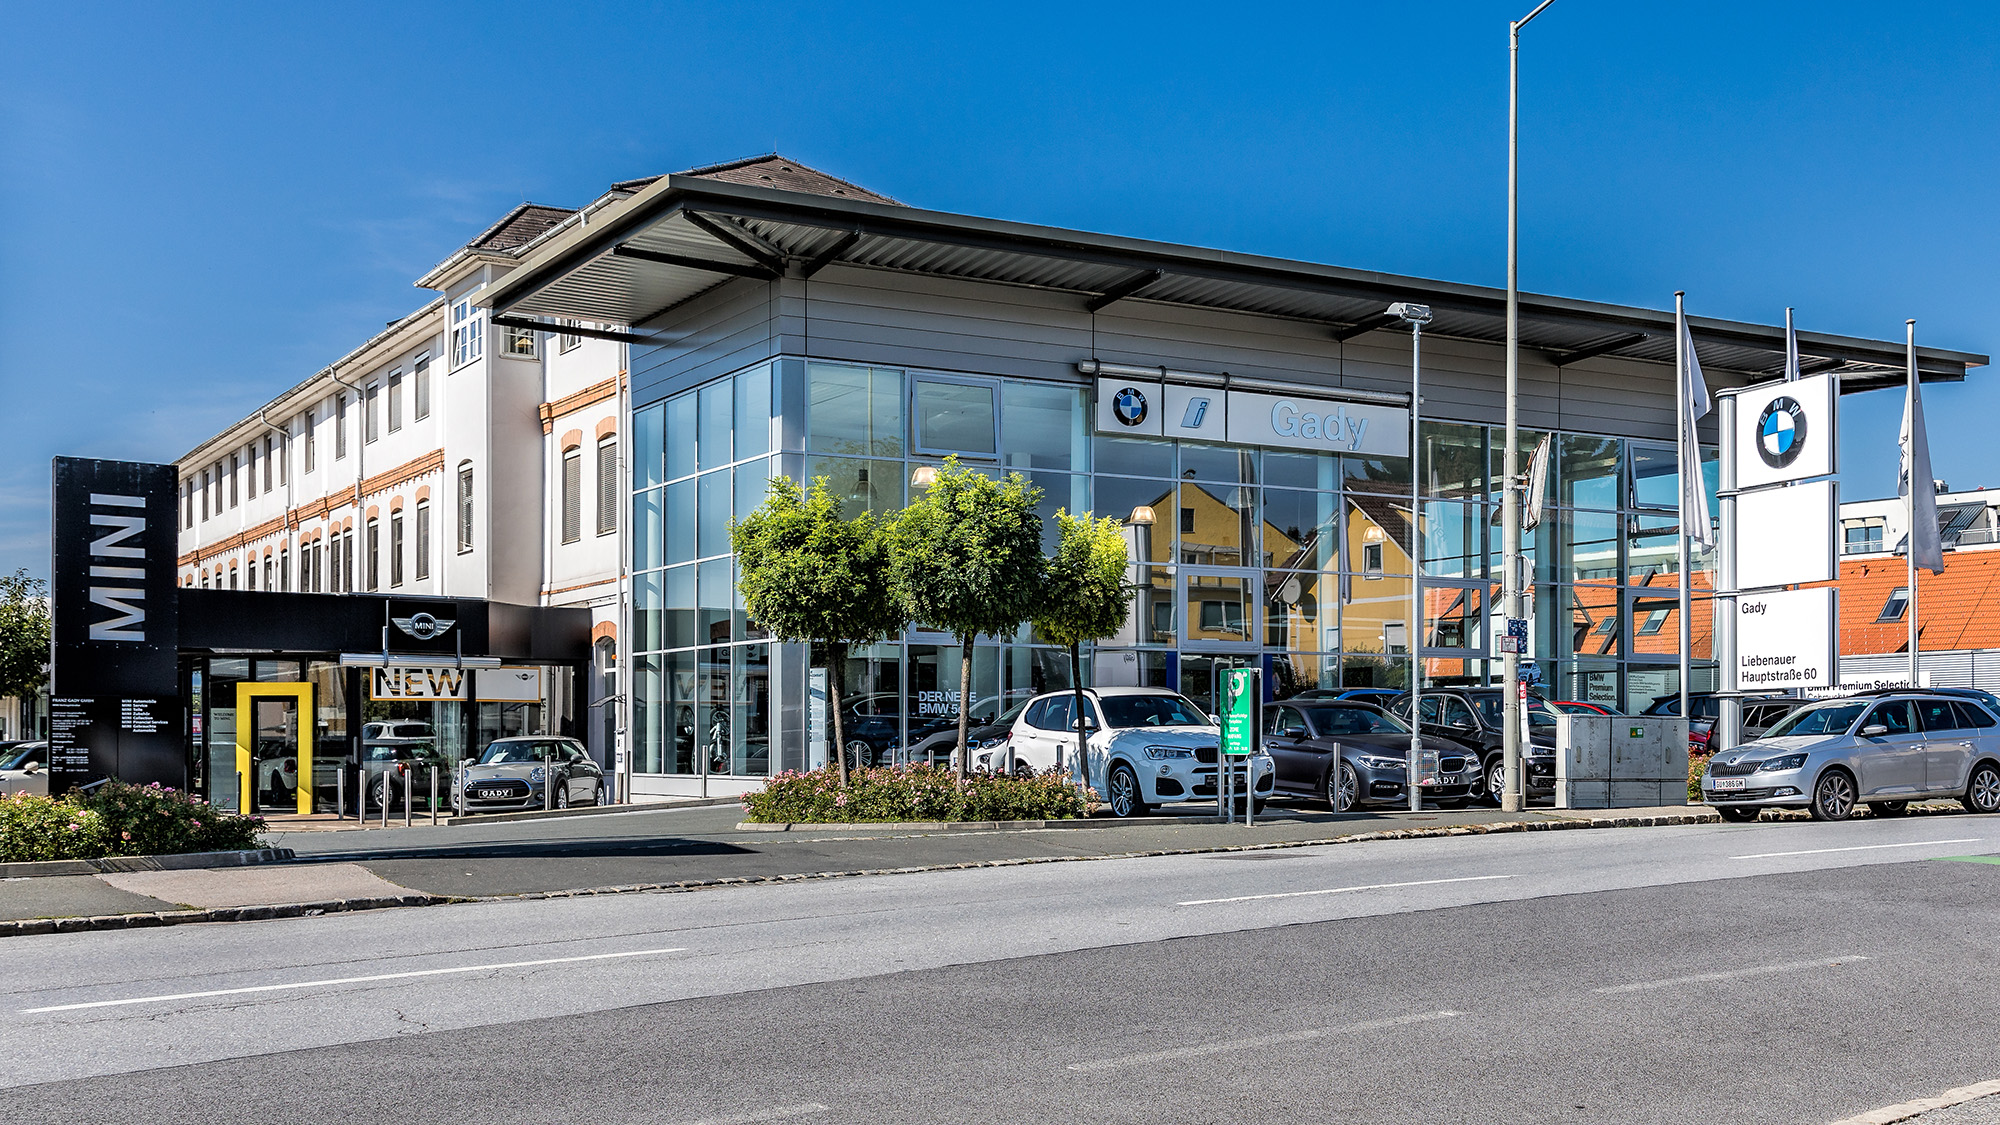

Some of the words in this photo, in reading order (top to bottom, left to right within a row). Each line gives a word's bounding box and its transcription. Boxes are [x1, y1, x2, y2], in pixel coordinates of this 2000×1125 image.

[1116, 388, 1146, 403] BMW
[1760, 398, 1802, 426] BMW
[1271, 400, 1369, 451] Gady
[89, 493, 146, 642] MINI
[1741, 601, 1767, 616] Gady
[414, 622, 434, 630] MINI
[1741, 655, 1797, 667] Liebenauer
[375, 667, 465, 697] NEW
[1589, 673, 1605, 682] BMW
[1741, 668, 1802, 684] Hauptstraße
[1803, 667, 1818, 680] 60
[1589, 683, 1614, 692] Premium
[919, 691, 943, 702] DER
[945, 691, 977, 702] NEE
[919, 703, 949, 714] BMW
[481, 789, 509, 797] GADY
